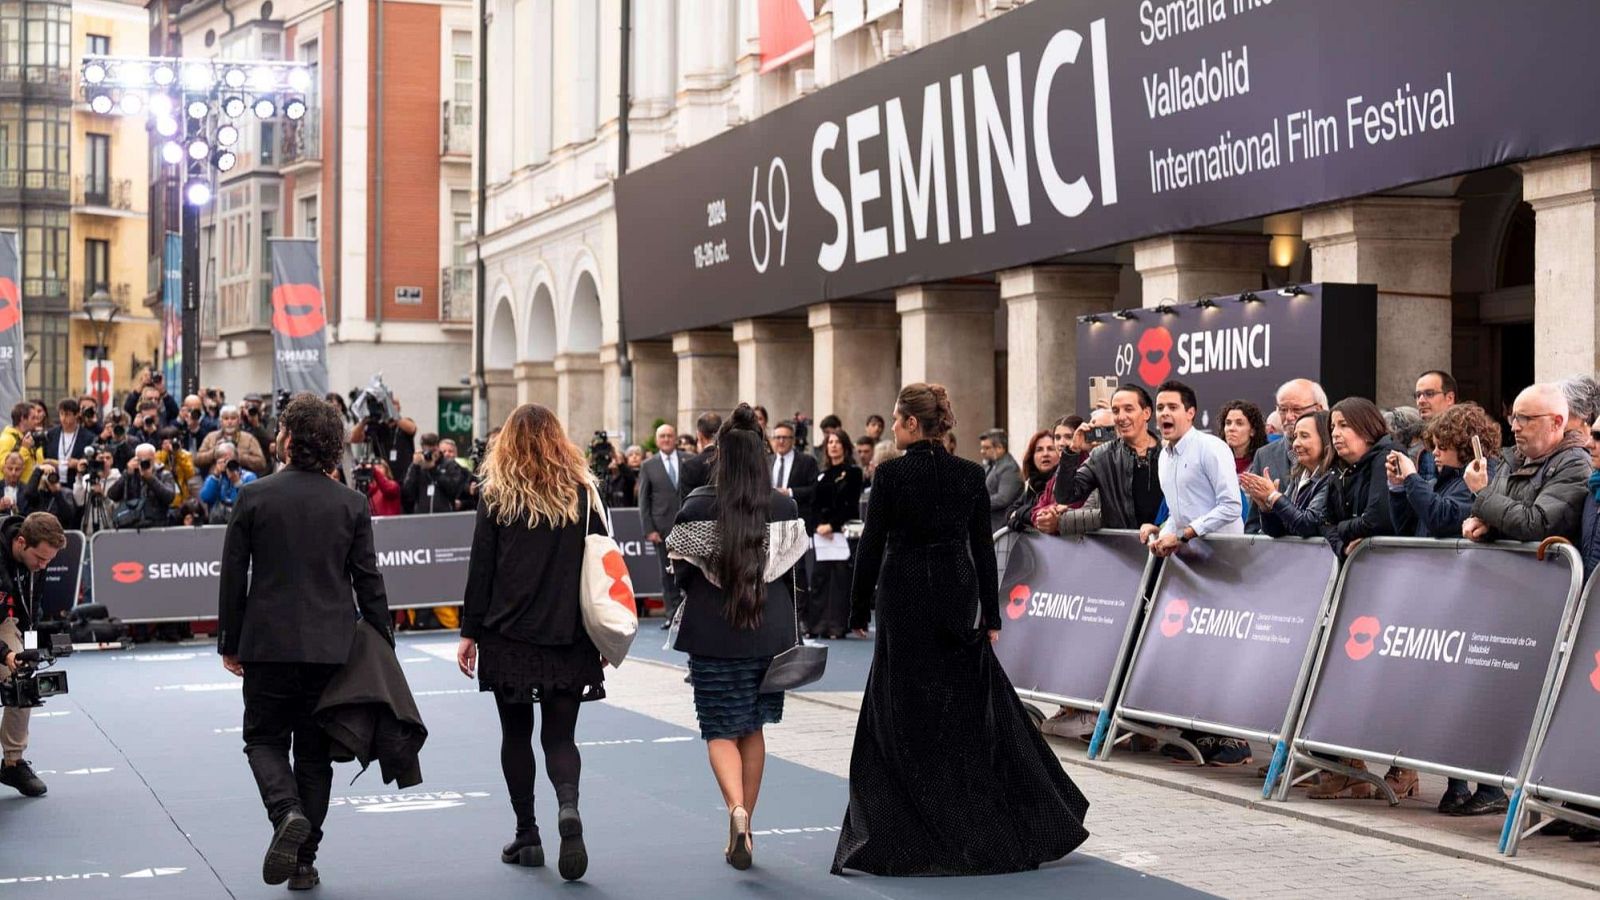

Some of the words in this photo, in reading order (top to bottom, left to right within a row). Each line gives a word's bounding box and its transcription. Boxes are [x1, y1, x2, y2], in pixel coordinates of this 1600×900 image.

[1139, 0, 1227, 46] Semana
[1142, 45, 1250, 119] Valladolid
[748, 156, 790, 274] 69
[811, 17, 1118, 273] SEMINCI
[1149, 117, 1281, 194] International
[1287, 108, 1339, 163] Film
[1346, 71, 1455, 149] Festival
[1115, 343, 1134, 376] 69
[1177, 323, 1271, 375] SEMINCI
[148, 560, 221, 580] SEMINC
[376, 548, 431, 567] MINCI
[1028, 591, 1084, 622] SEMINCI
[1186, 607, 1255, 639] SEMINCI
[1378, 625, 1466, 664] SEMINCI
